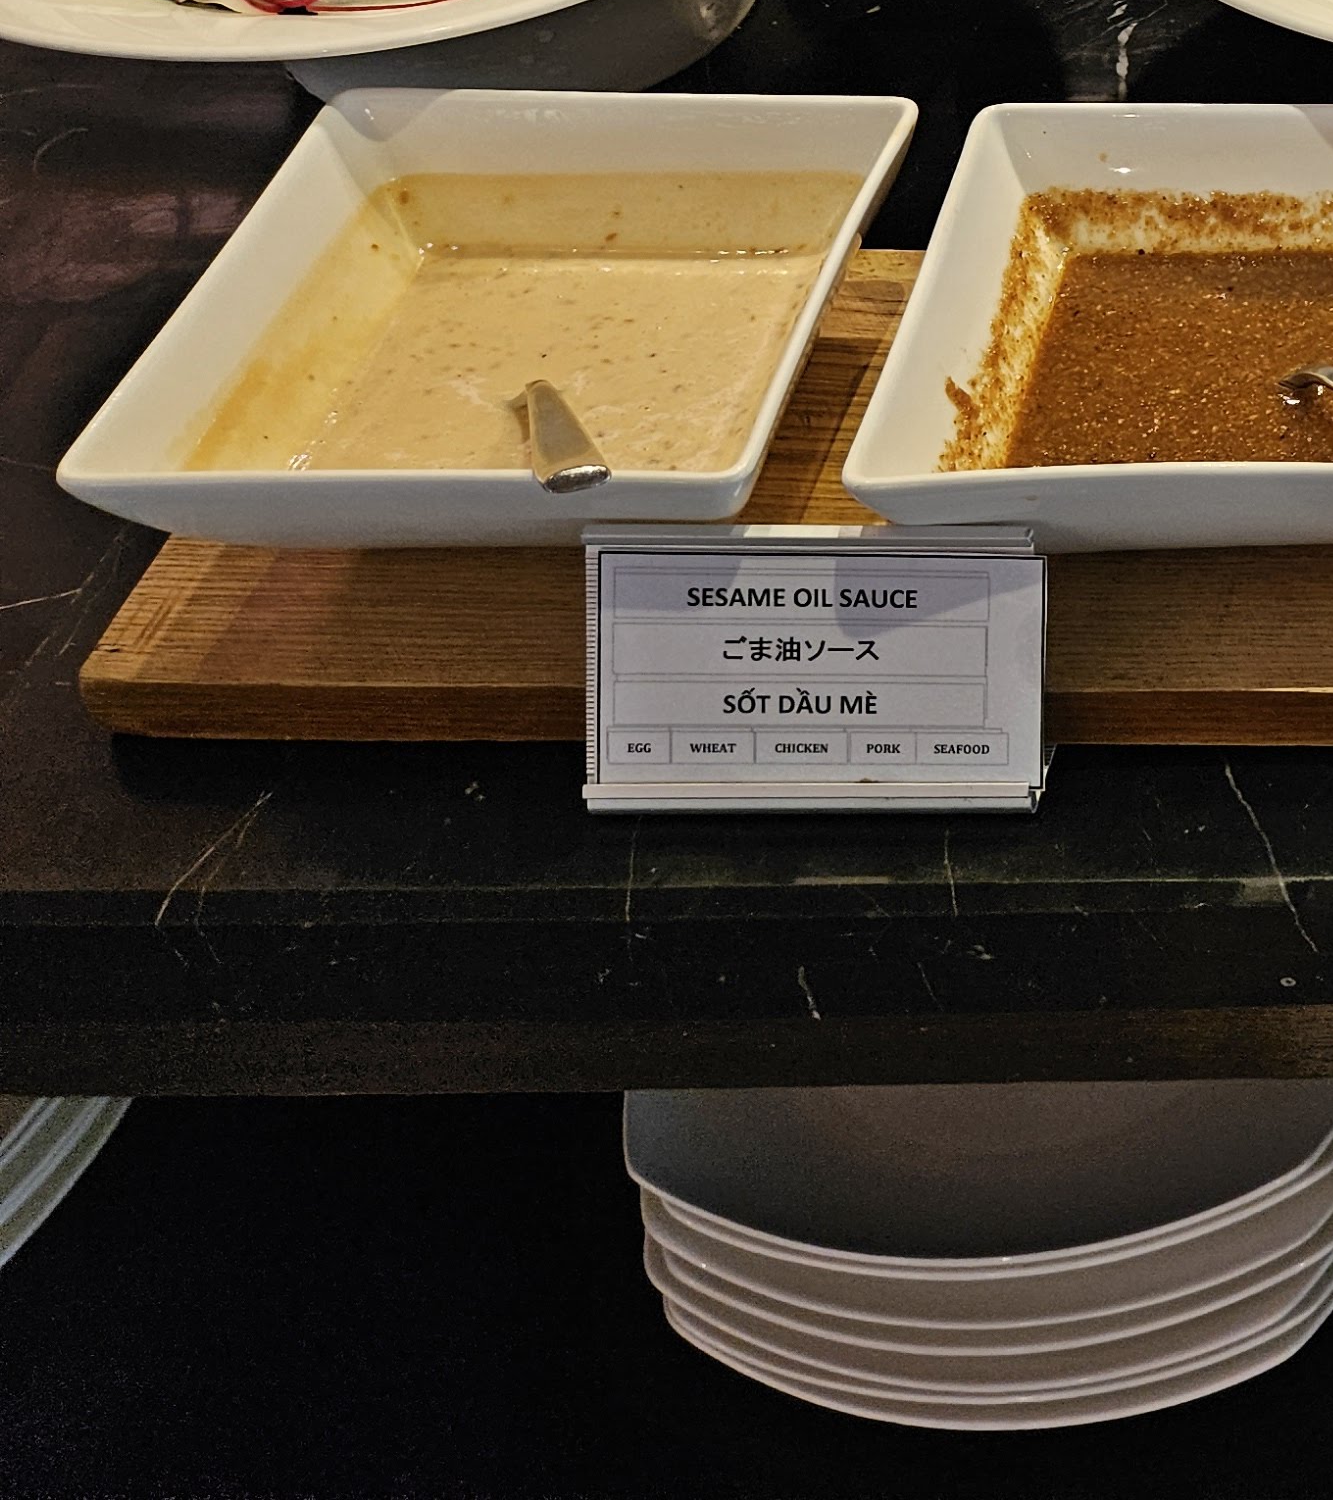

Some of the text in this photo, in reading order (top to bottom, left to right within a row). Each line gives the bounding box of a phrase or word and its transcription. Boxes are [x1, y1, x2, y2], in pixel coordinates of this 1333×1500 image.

[687, 586, 918, 610] SESAME OIL SAUCE
[722, 636, 879, 662] ごま油ソース
[723, 687, 877, 715] SỐT DẦU MÈ
[627, 742, 990, 755] EGG WHEAT CHICKEN PORK SEAFOOD
